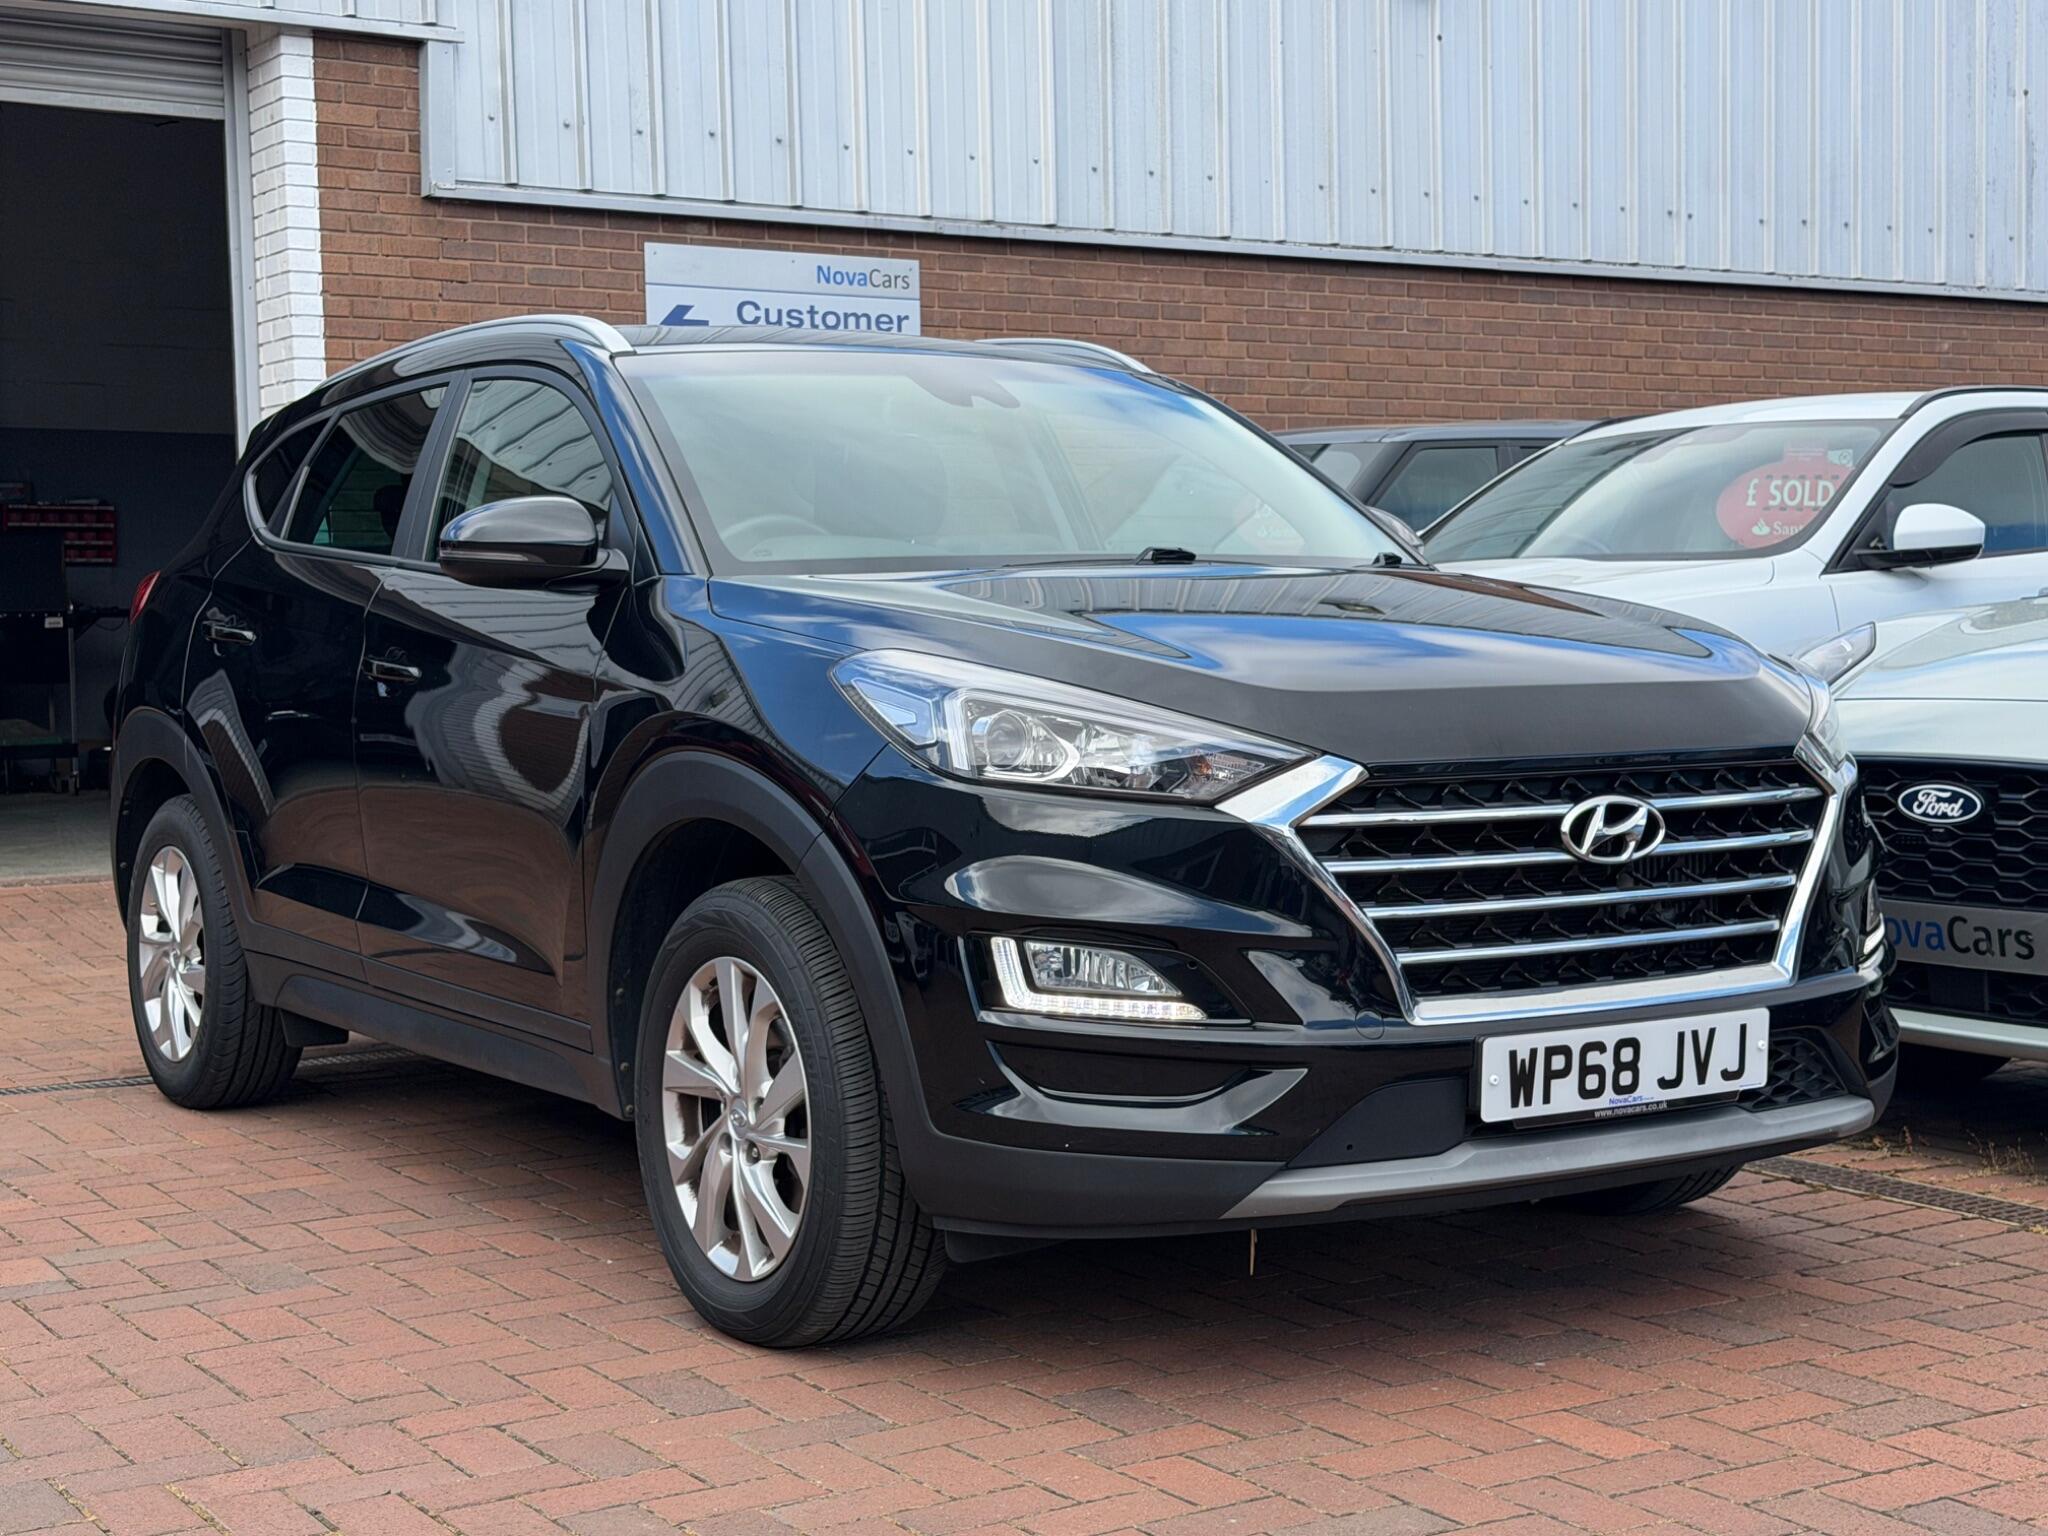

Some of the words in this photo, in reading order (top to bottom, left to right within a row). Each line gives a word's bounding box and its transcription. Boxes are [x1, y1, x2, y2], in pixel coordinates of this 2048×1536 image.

[816, 265, 911, 290] NovaCars
[736, 300, 909, 332] Customer
[1768, 479, 1836, 507] SOLD
[1912, 789, 1963, 817] Ford
[1884, 916, 2035, 960] ovaCars
[1509, 1037, 1641, 1108] WP68
[1657, 1023, 1747, 1091] JVJ
[1594, 1100, 1668, 1118] www.novacars.co.uk
